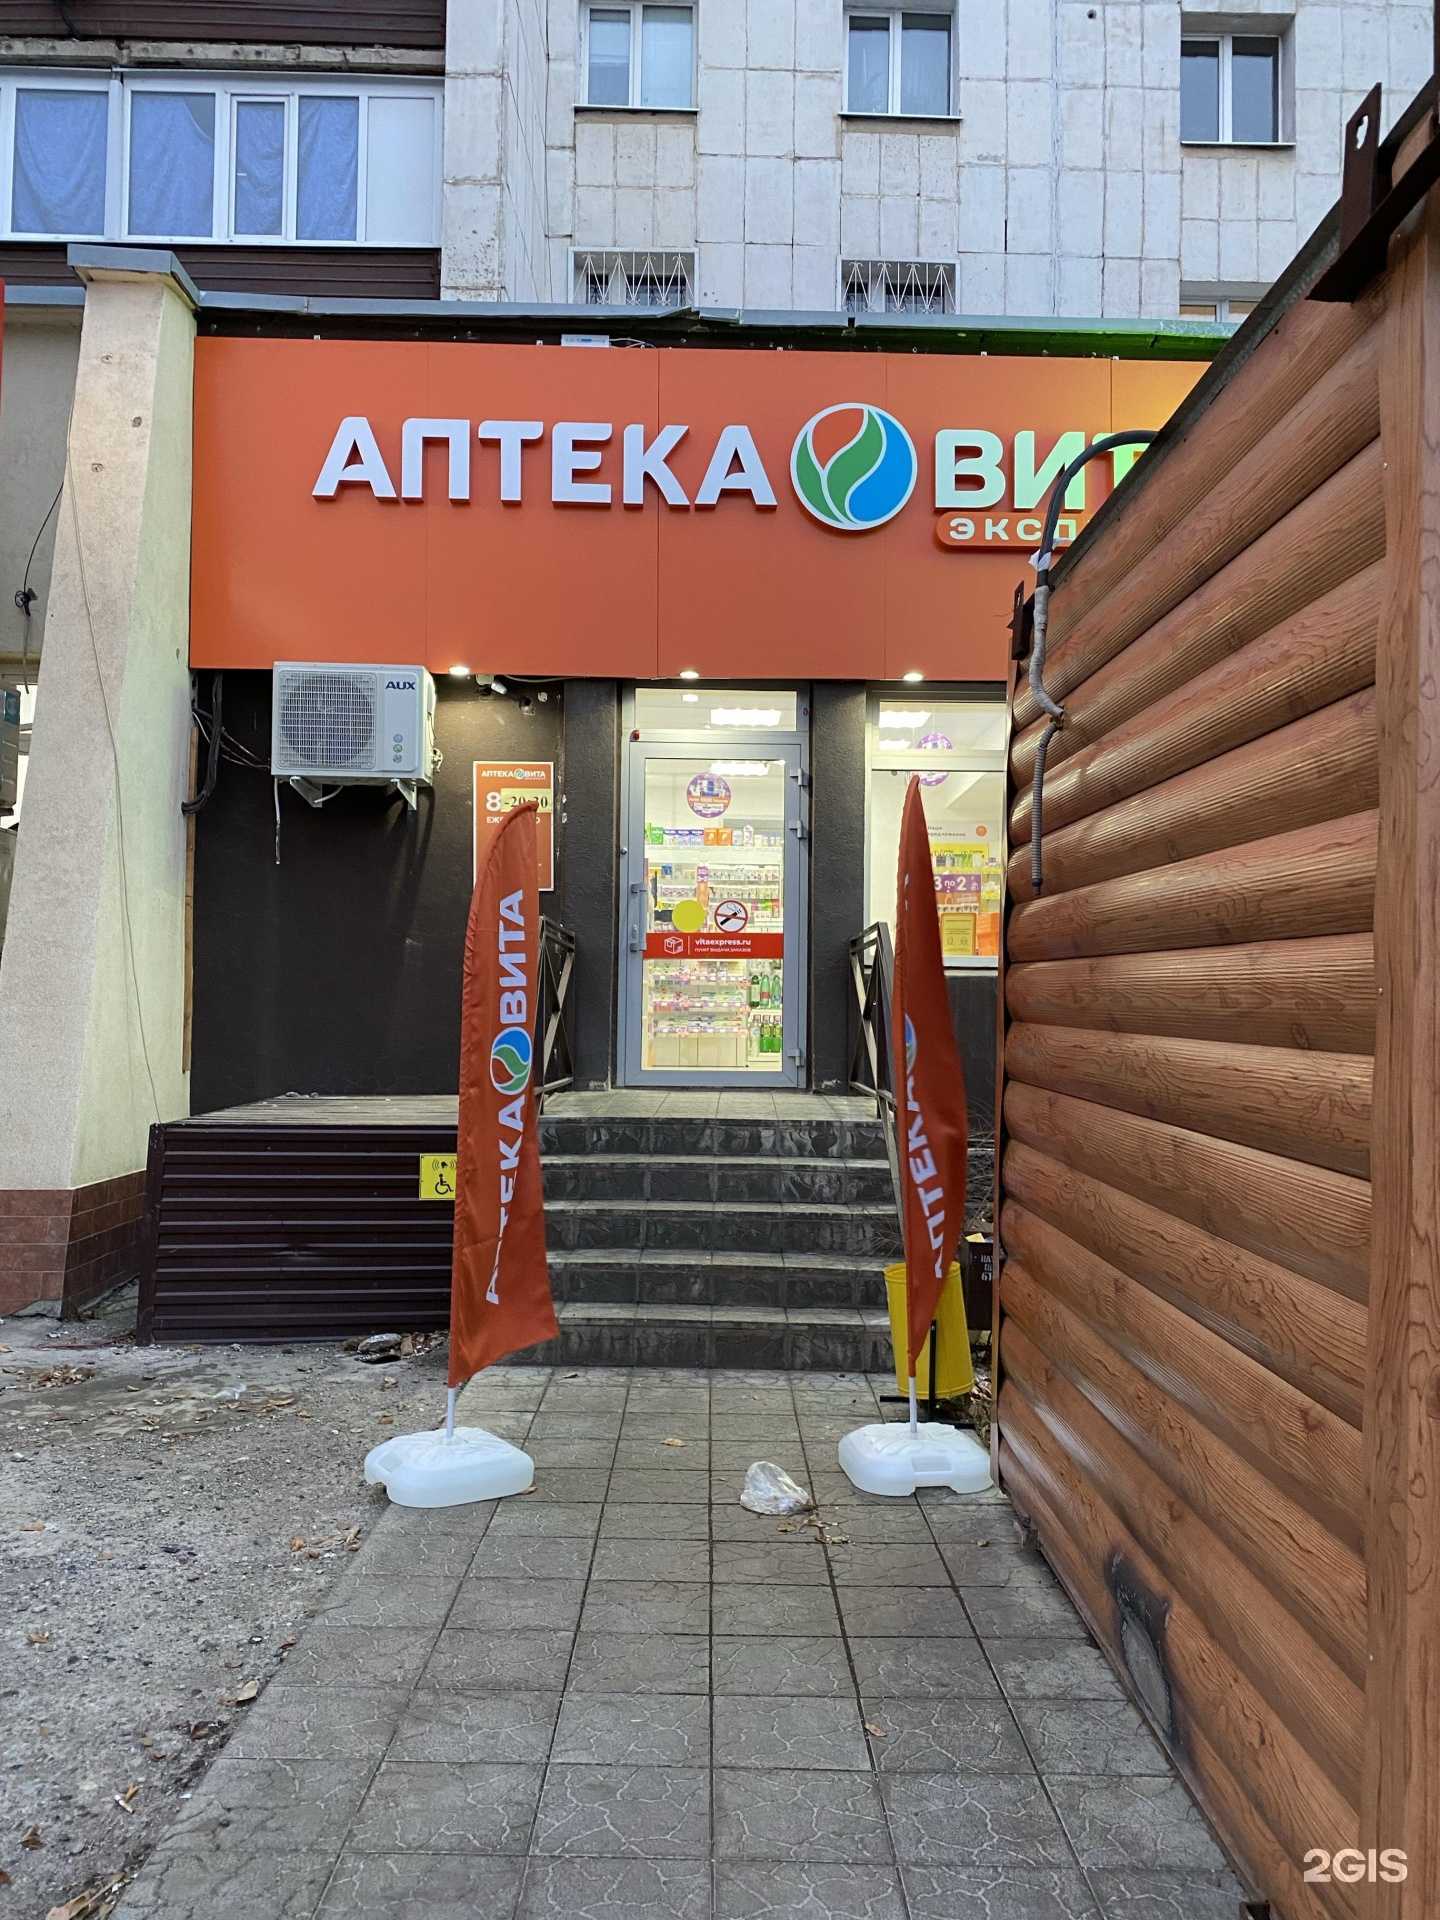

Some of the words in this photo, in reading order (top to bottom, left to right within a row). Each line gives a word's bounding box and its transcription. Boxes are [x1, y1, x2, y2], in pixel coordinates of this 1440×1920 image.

[312, 416, 778, 508] АПТЕКА
[385, 681, 416, 690] AUX
[523, 770, 546, 778] ВИТА
[486, 791, 501, 812] 8
[957, 876, 967, 891] 2
[695, 938, 751, 947] vitaexpress.ru
[499, 888, 528, 1025] ВИТА
[486, 1094, 526, 1305] ТЕКА
